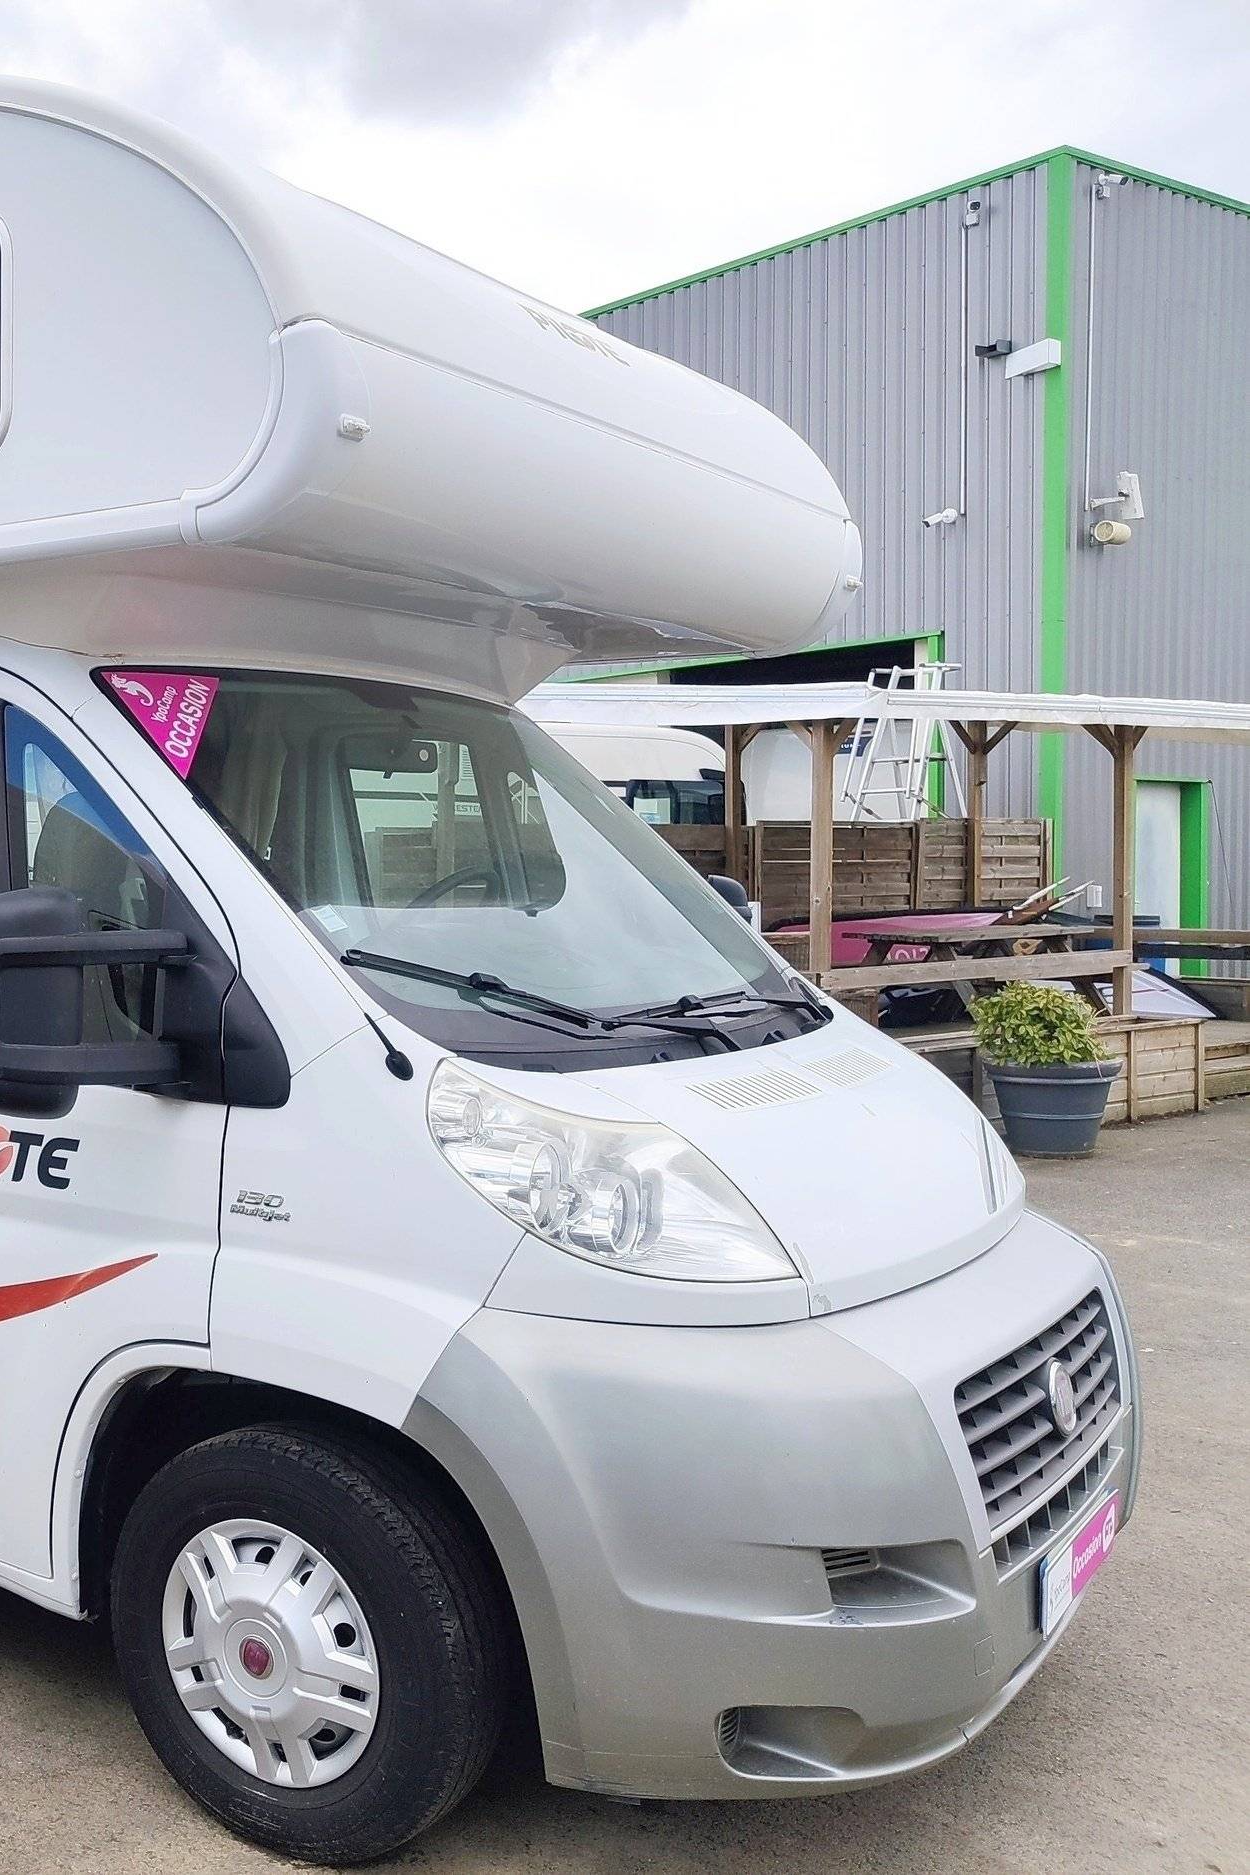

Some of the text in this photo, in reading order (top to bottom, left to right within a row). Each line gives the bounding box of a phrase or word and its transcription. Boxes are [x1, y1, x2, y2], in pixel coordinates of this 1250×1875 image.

[151, 685, 178, 723] YpoCamp
[164, 678, 211, 758] OCCASION
[237, 1190, 284, 1207] 130
